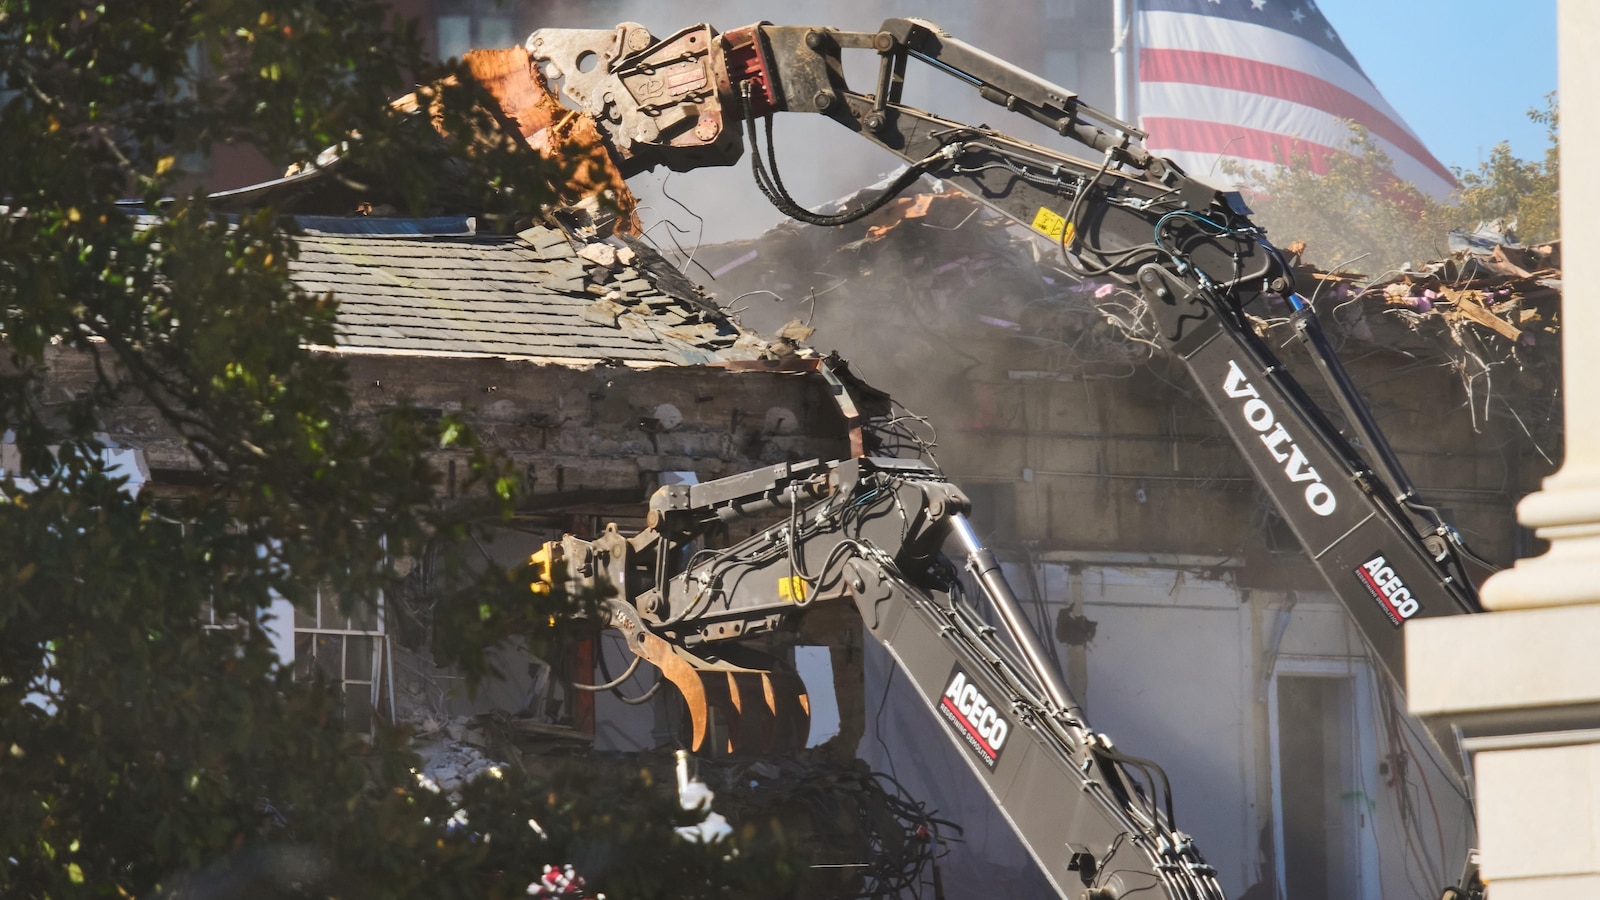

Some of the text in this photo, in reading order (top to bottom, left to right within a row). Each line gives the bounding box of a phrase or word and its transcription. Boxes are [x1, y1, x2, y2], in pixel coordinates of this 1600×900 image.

[1222, 359, 1337, 517] VOLVO
[1354, 569, 1400, 626] REDEFINING DEMOLITION
[1362, 556, 1419, 619] ACECO
[939, 703, 994, 767] REDEFINING DEMOLITION
[945, 671, 1008, 751] ACECO
